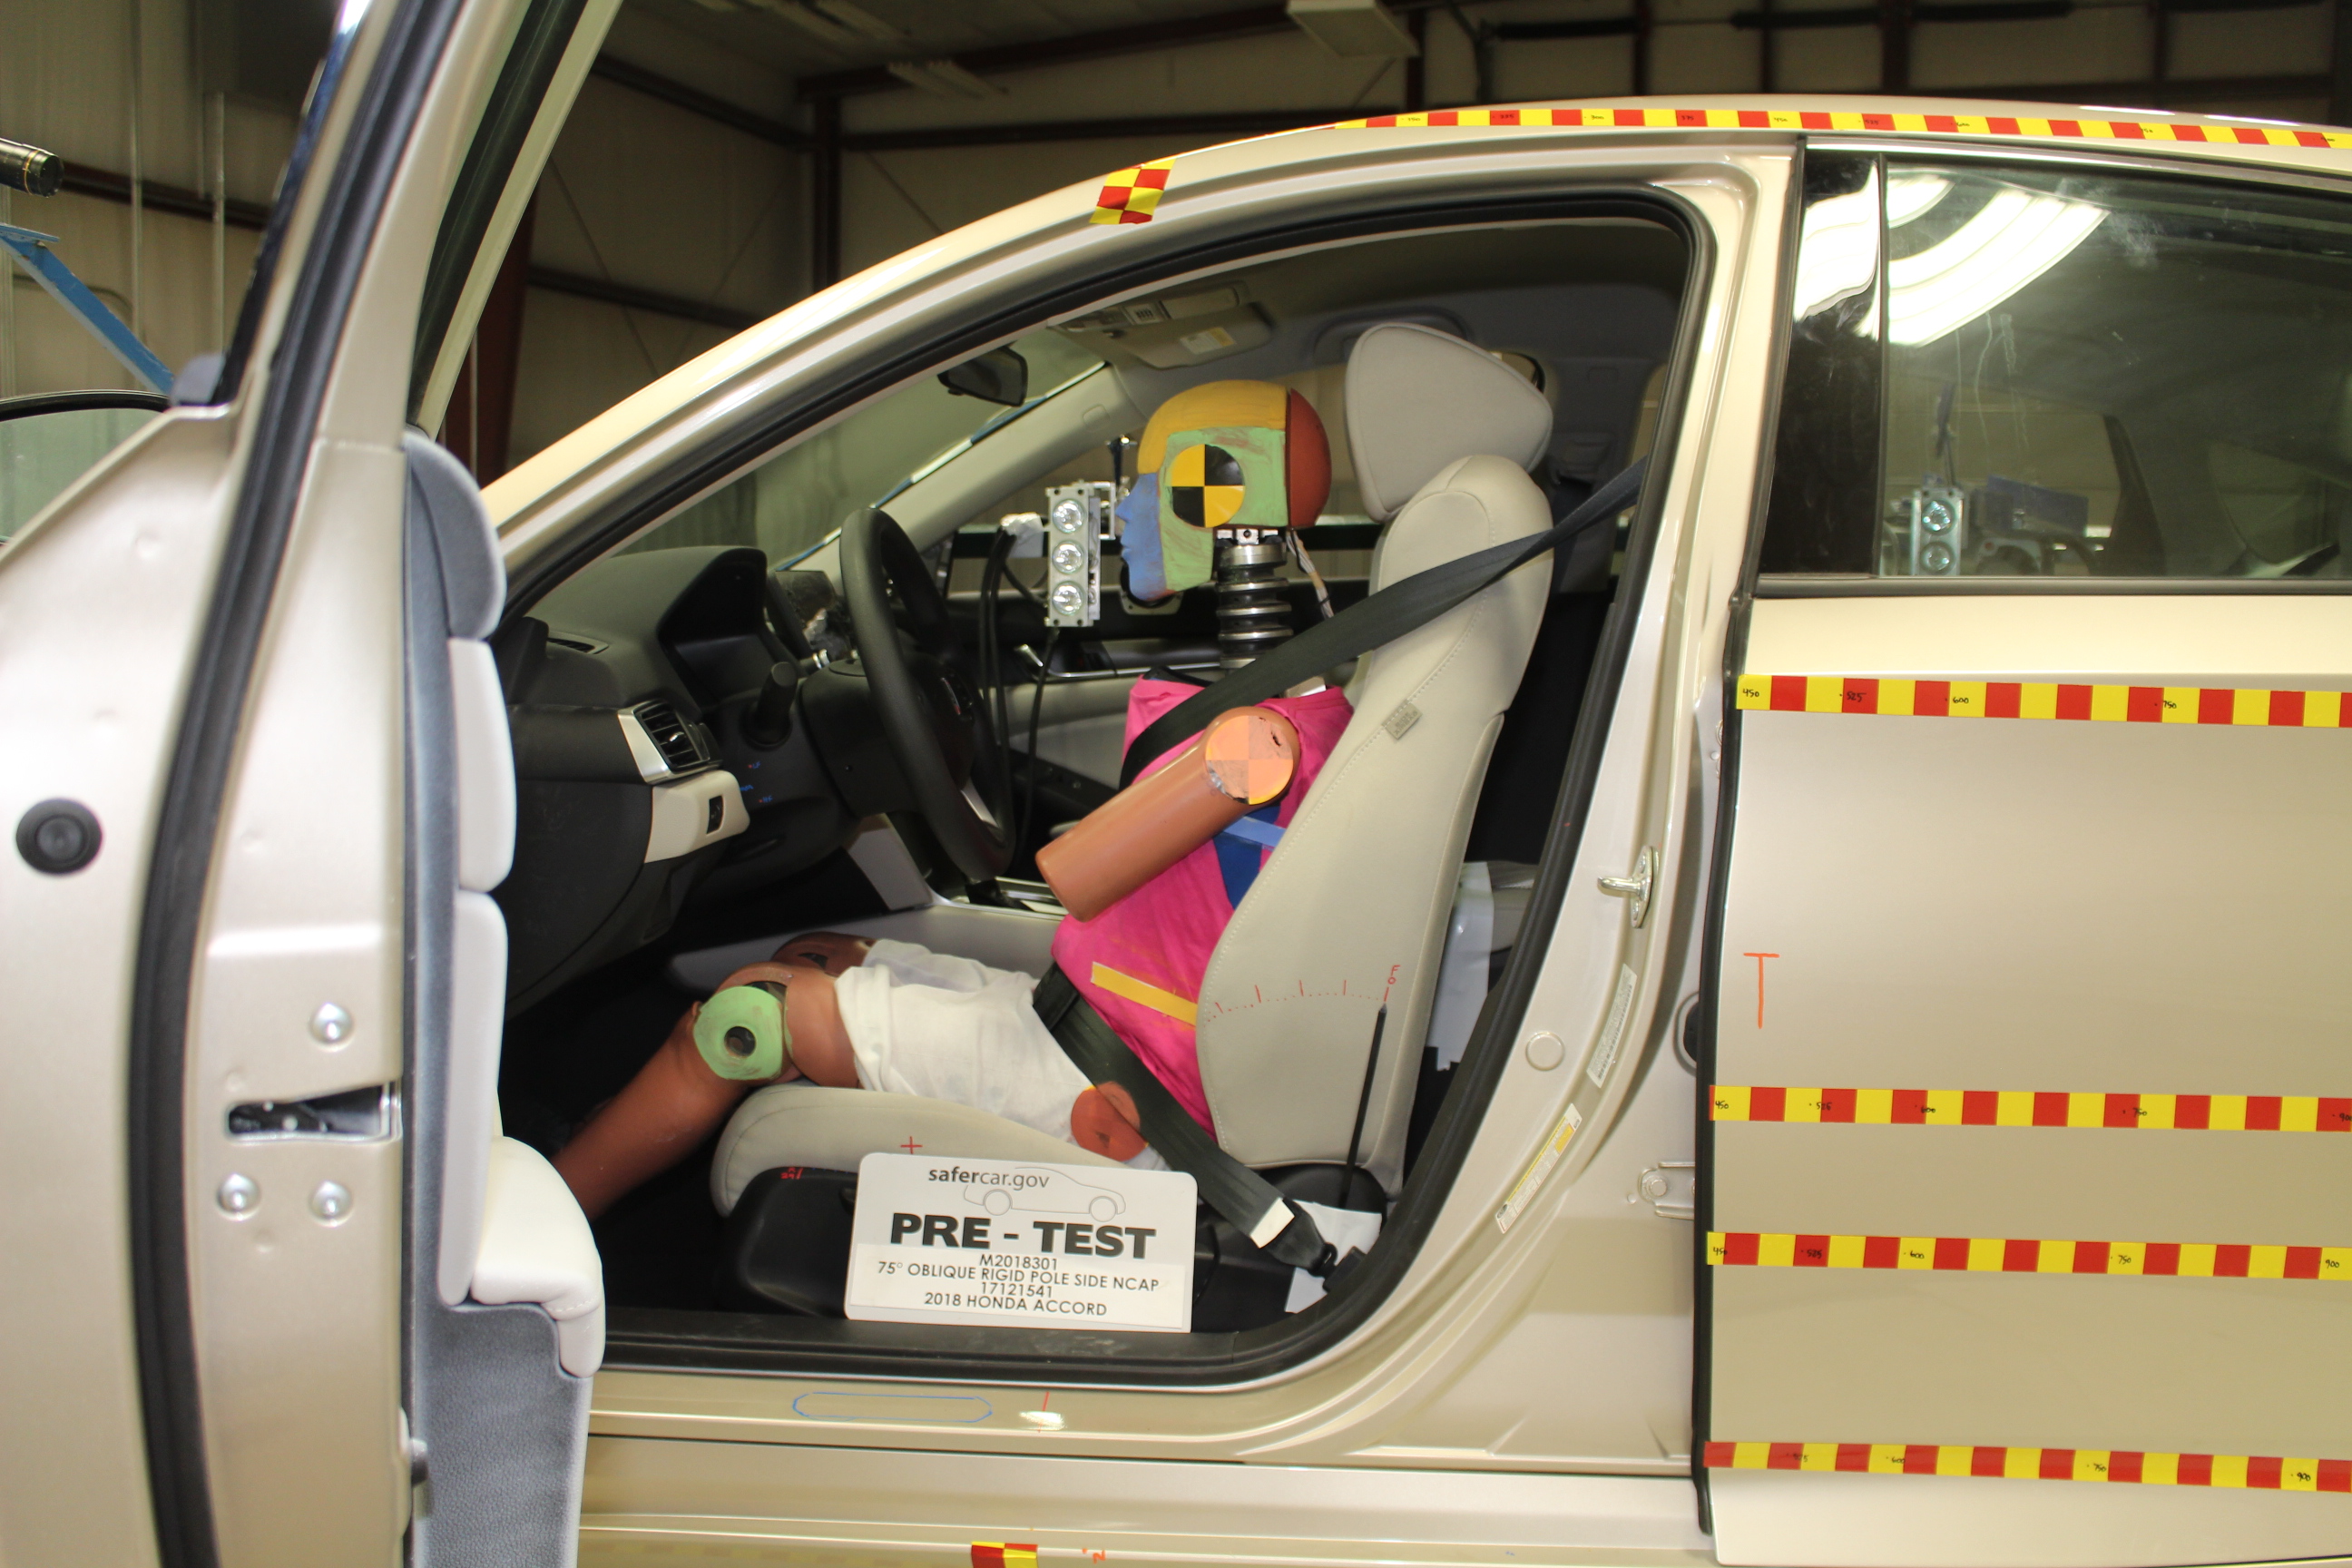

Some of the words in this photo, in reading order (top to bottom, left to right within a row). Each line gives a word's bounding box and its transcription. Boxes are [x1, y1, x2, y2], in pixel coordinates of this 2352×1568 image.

[1742, 688, 1760, 698] 450
[1846, 691, 1867, 702] 525
[1952, 696, 1970, 704] 600
[2162, 700, 2178, 710] 750
[1715, 1100, 1730, 1110] 450
[1920, 1105, 1936, 1114] 600
[2132, 1107, 2148, 1117] 750
[928, 1166, 1050, 1191] safercar.gov
[890, 1212, 992, 1250] PRE
[1033, 1220, 1157, 1259] TEST
[979, 1253, 1057, 1270] M2018301
[1712, 1246, 1728, 1256] 450
[1807, 1249, 1823, 1259] 525
[1910, 1250, 1925, 1259] 600
[2117, 1254, 2132, 1265] 750
[2325, 1259, 2340, 1269] 900
[878, 1261, 903, 1275] 75°
[907, 1263, 976, 1279] OBLIQUE
[981, 1268, 1024, 1282] RIGID
[1031, 1270, 1070, 1285] POLE
[1074, 1274, 1108, 1289] SIDE
[1113, 1277, 1160, 1291] NCAP
[981, 1281, 1053, 1298] 17121541
[924, 1292, 962, 1307] 2018
[967, 1295, 1027, 1310] HONDA
[1034, 1299, 1107, 1316] ACCORD
[2092, 1463, 2107, 1473] 750
[2297, 1472, 2311, 1482] 900
